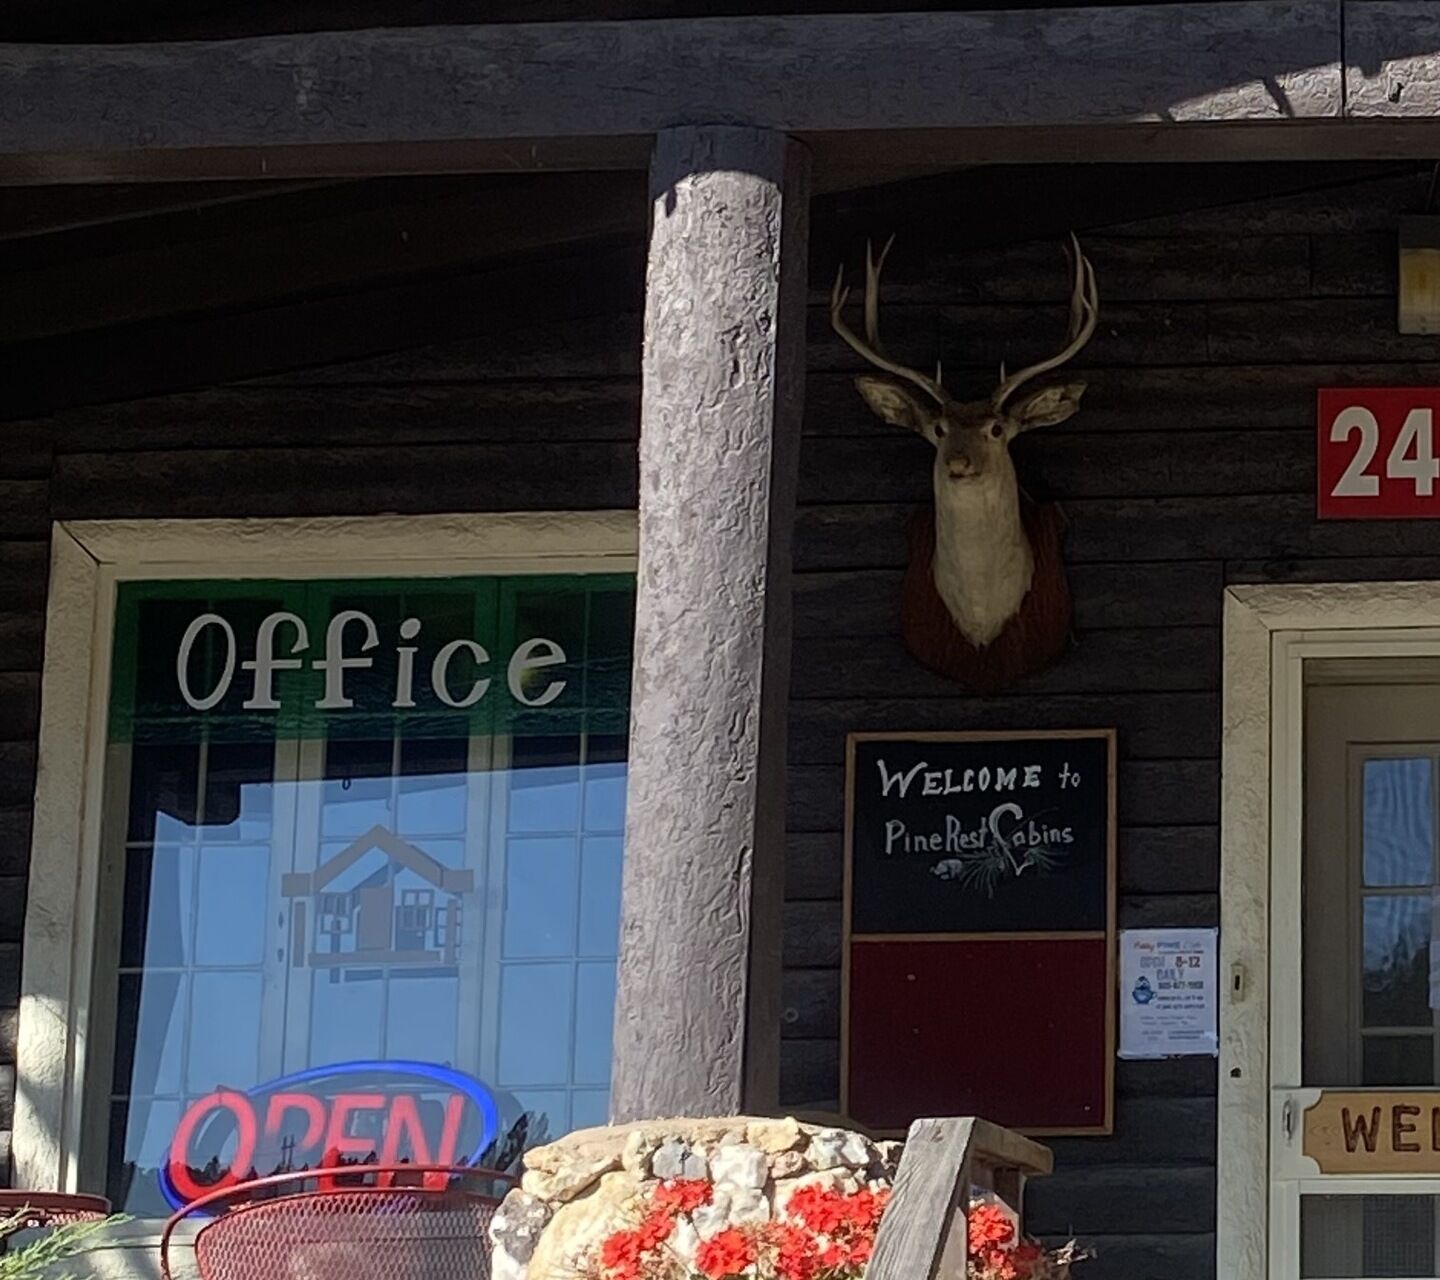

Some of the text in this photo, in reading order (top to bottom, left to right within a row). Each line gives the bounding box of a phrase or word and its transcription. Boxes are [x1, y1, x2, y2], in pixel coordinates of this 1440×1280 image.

[176, 609, 568, 711] Office
[876, 759, 1082, 798] WELCOME to
[168, 1090, 467, 1202] OPEN
